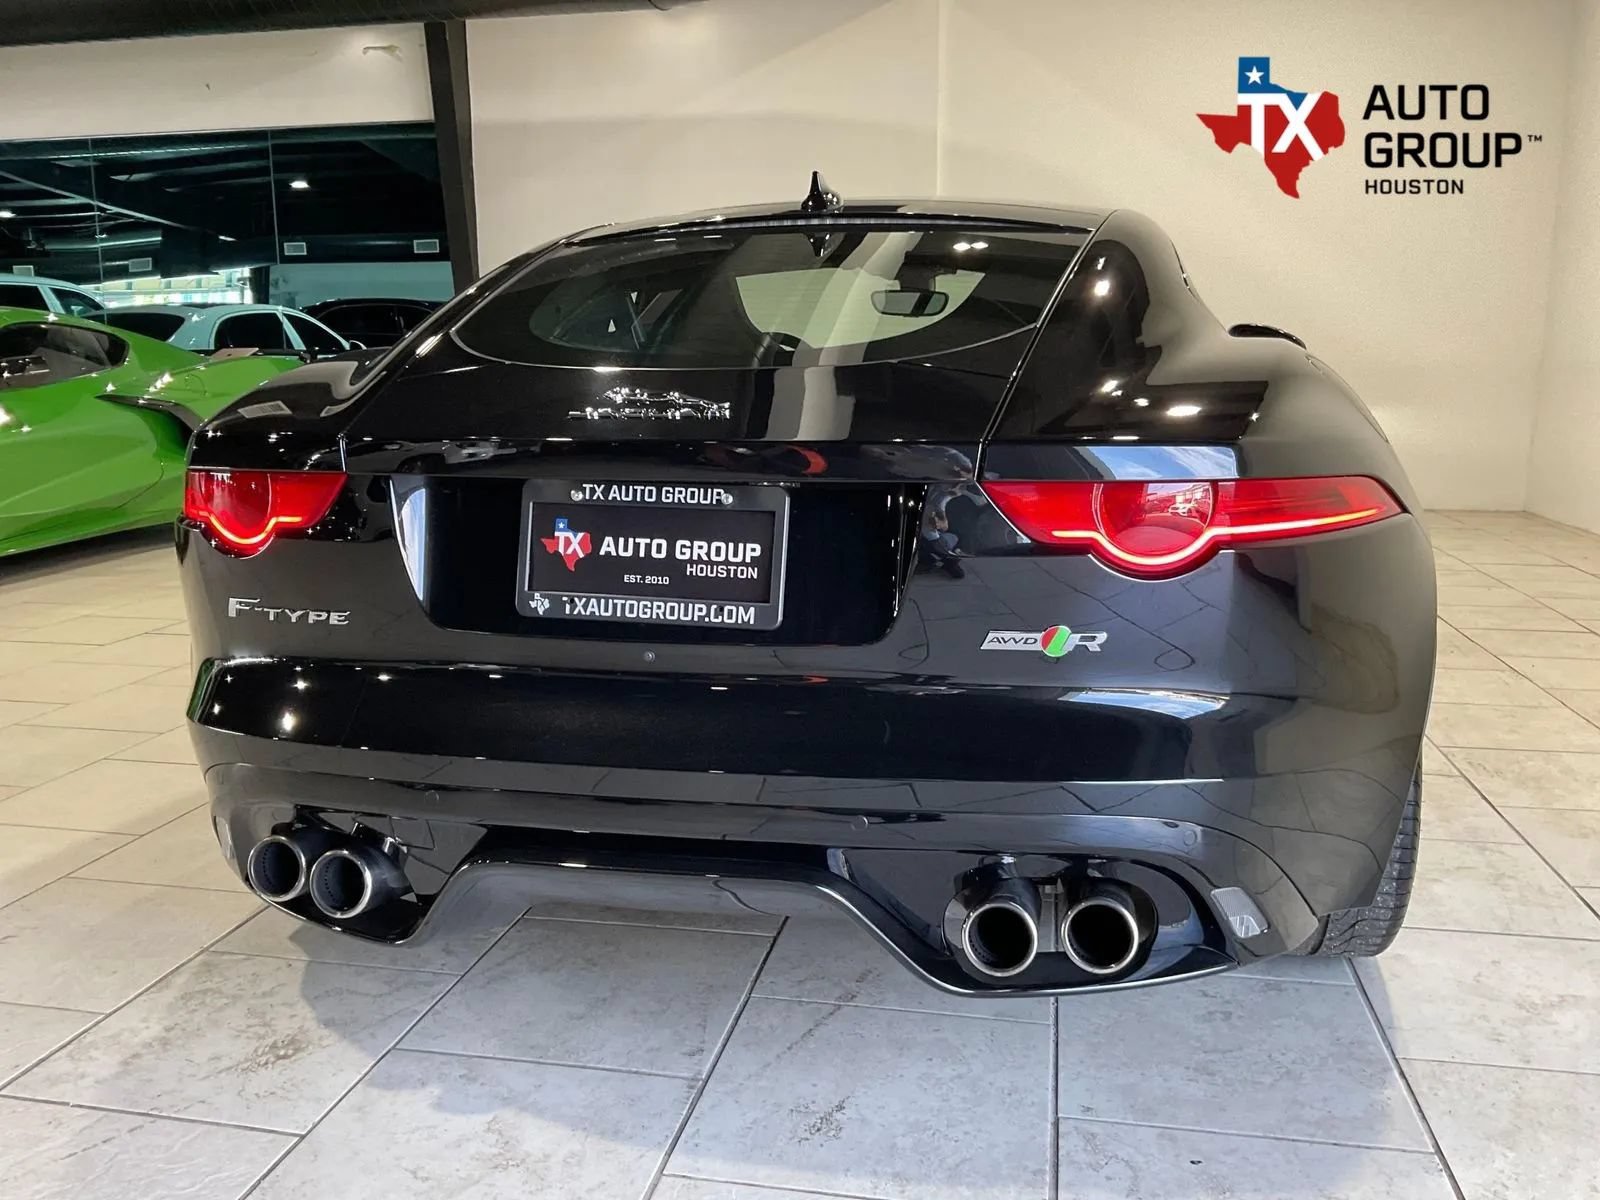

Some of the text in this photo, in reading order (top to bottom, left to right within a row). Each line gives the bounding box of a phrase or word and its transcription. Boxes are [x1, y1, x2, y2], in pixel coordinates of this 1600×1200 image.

[582, 483, 725, 505] TX AUTO GROUP
[555, 531, 585, 558] TX
[599, 536, 761, 563] AUTO GROUP
[624, 574, 670, 585] EST. 2010
[687, 563, 758, 579] HOUSTON
[987, 631, 1107, 651] AWD R
